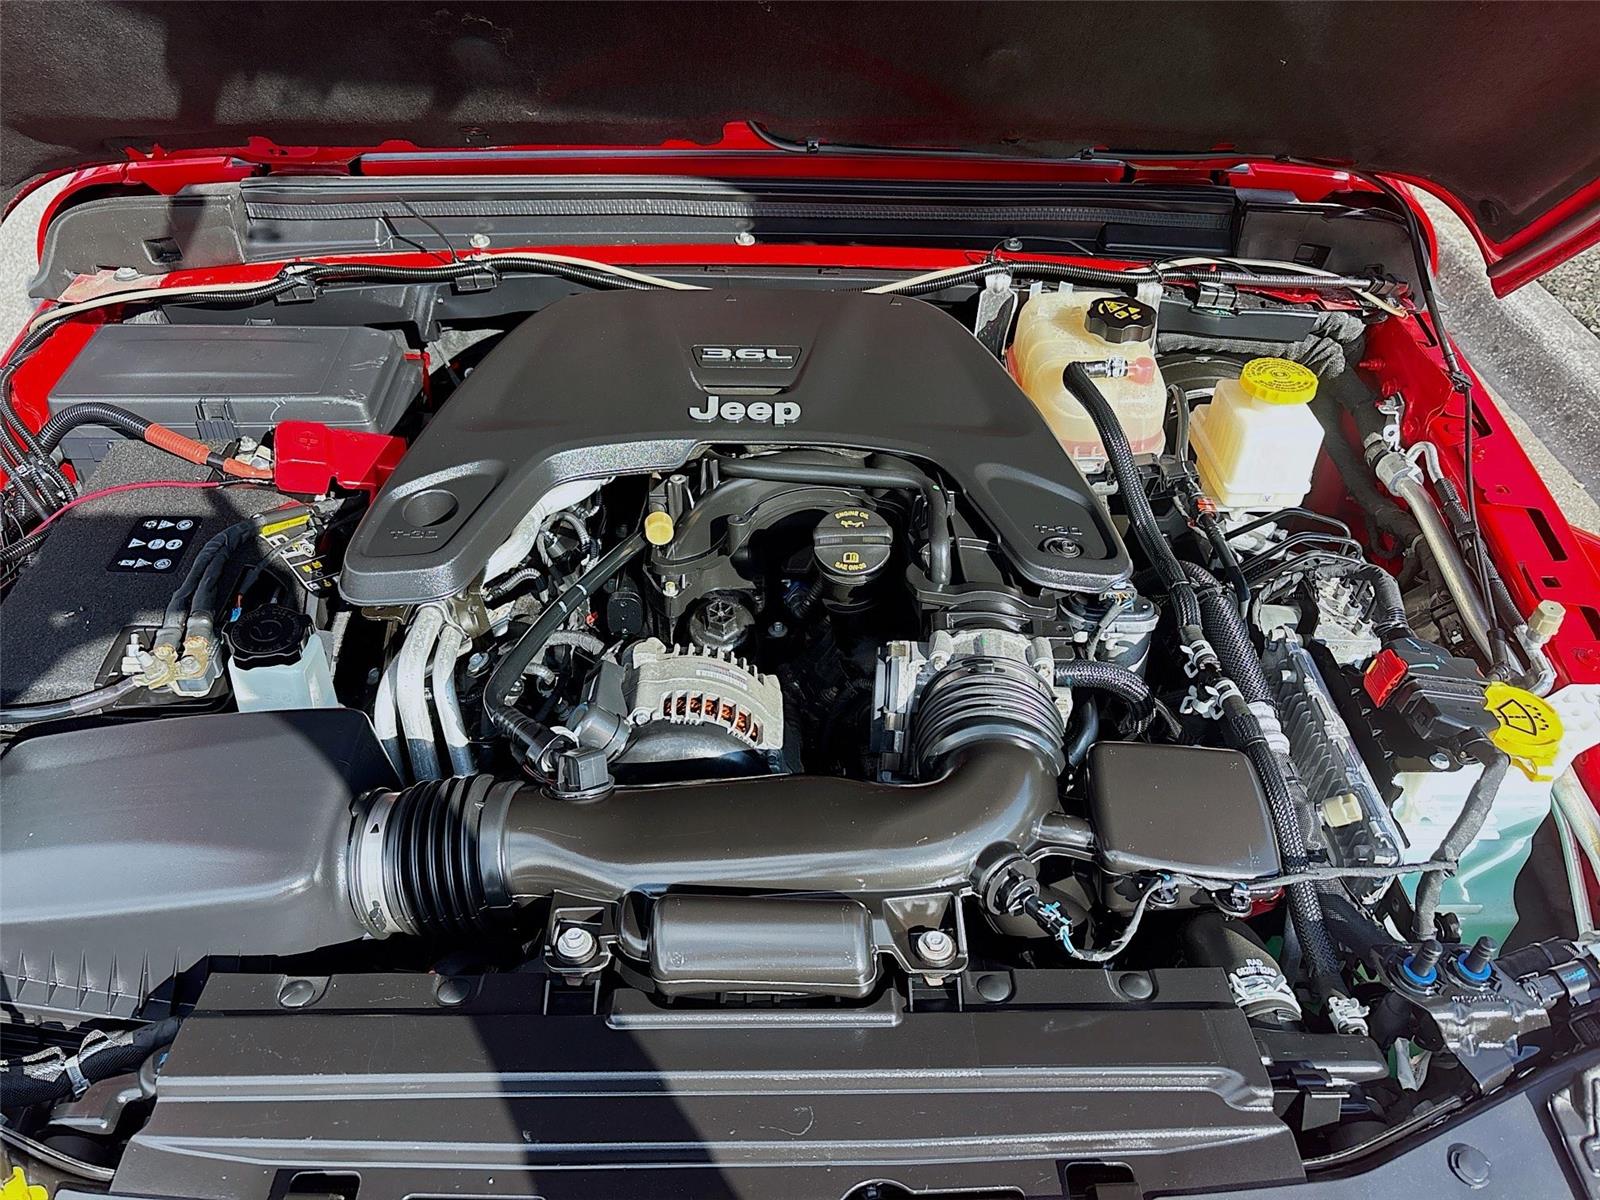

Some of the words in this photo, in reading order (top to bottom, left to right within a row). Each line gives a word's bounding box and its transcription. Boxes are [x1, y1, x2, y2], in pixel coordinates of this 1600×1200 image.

[701, 347, 793, 362] 3.6L
[688, 395, 802, 427] Jeep
[834, 511, 859, 519] ENGINE
[834, 561, 848, 570] SAE
[1245, 958, 1264, 967] RAD
